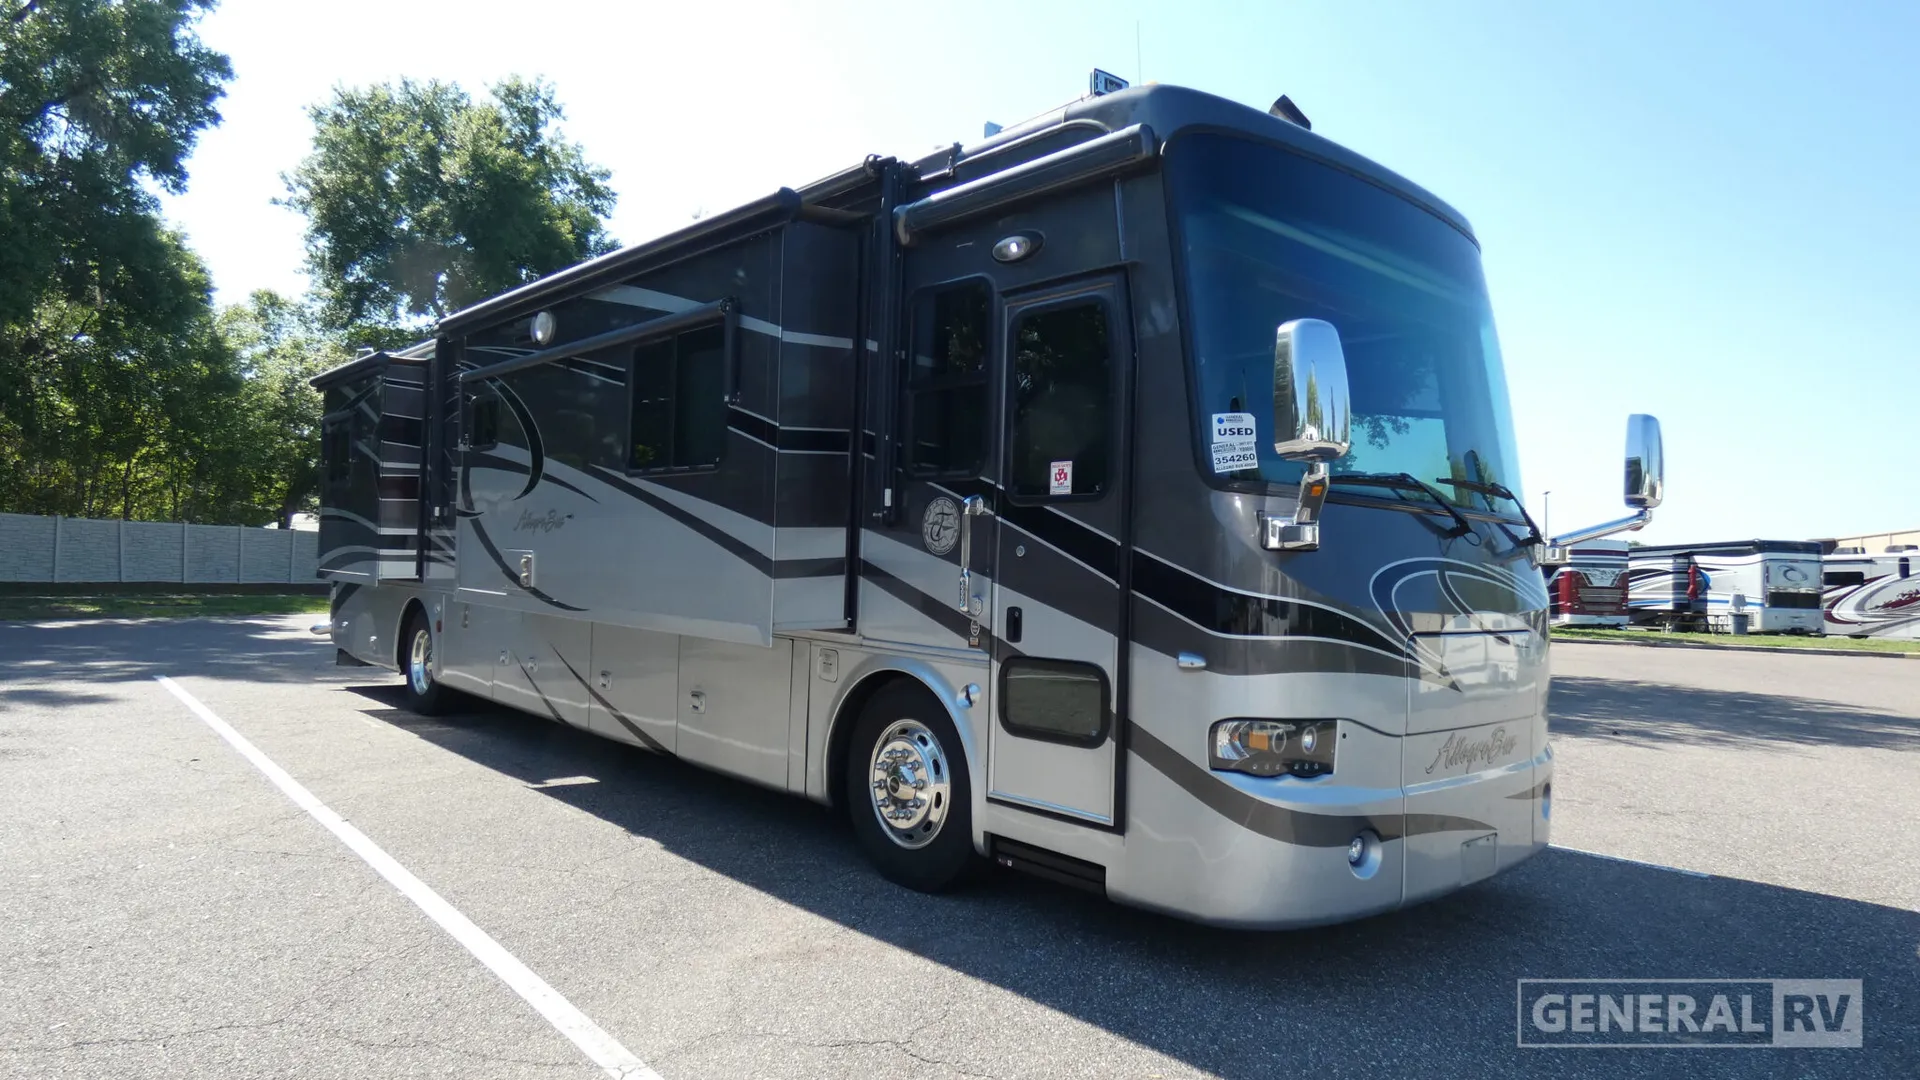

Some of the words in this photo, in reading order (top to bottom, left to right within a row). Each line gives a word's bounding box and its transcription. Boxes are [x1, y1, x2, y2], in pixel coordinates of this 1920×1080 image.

[1217, 427, 1254, 436] USED
[1215, 453, 1255, 465] 354260
[1425, 731, 1489, 774] Allegro
